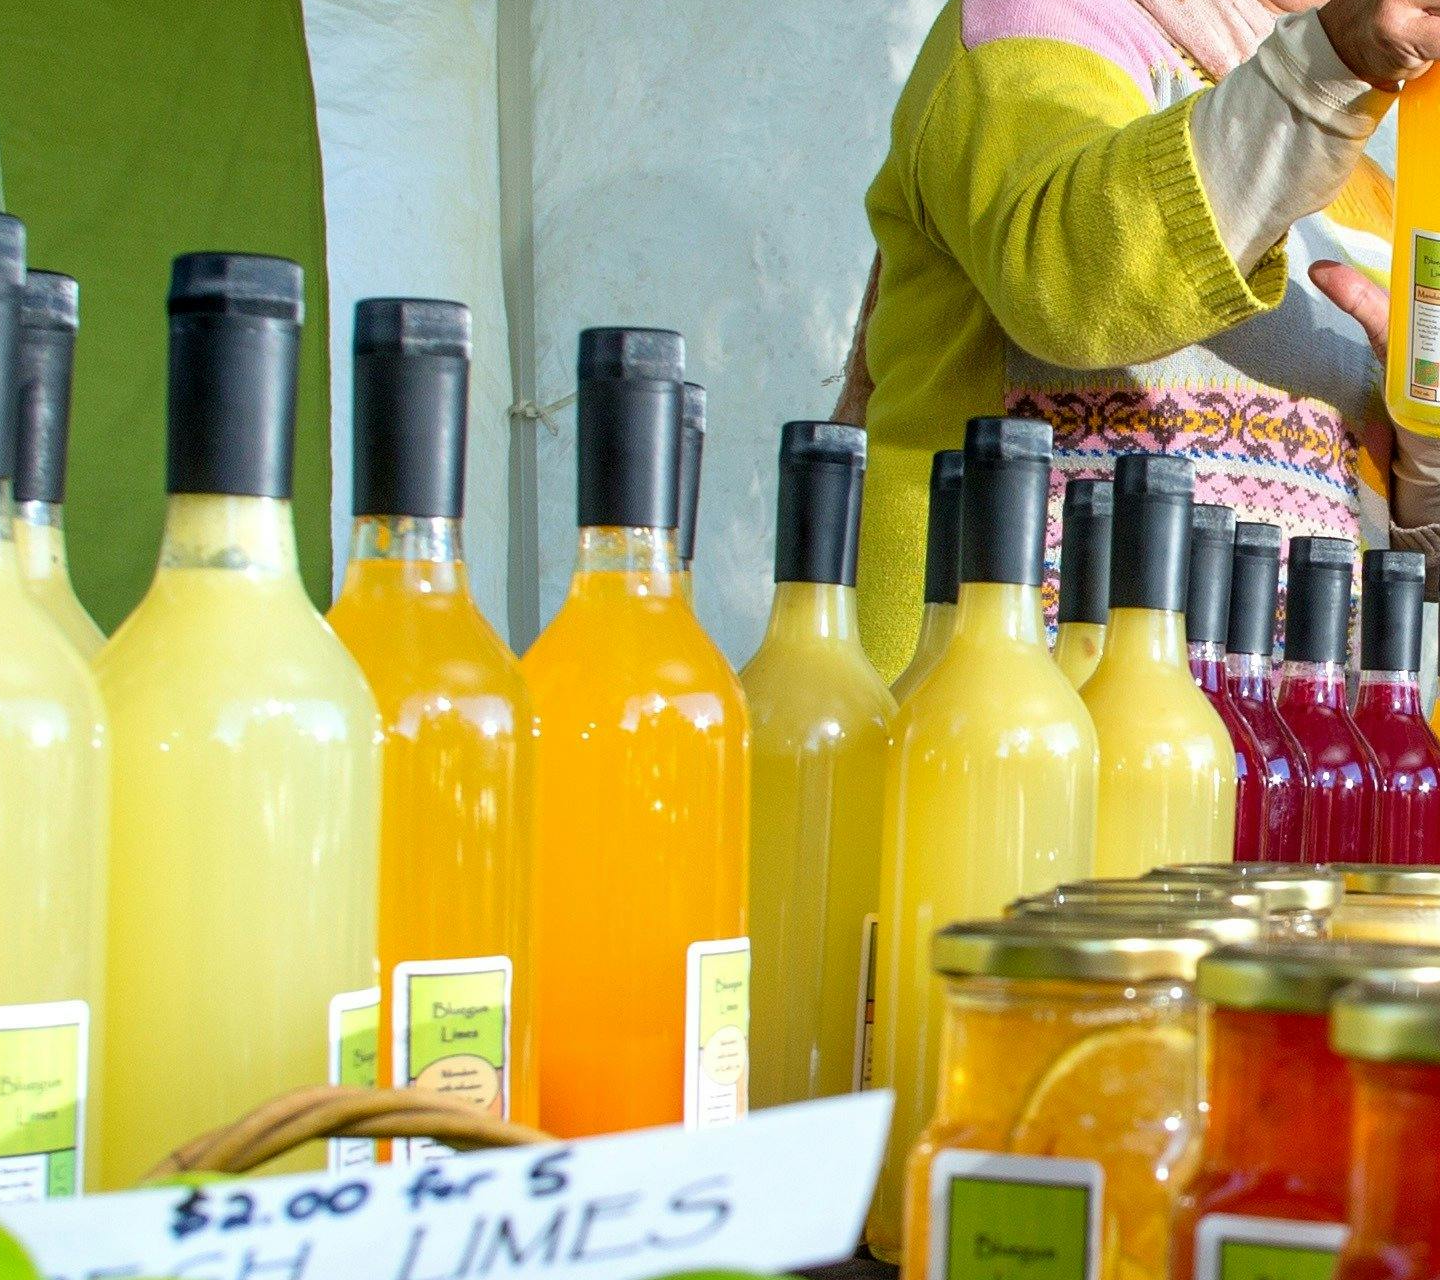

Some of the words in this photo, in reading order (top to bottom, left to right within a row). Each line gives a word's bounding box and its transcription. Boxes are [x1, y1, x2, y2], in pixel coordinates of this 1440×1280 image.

[168, 1176, 373, 1241] $2.00
[400, 1163, 497, 1213] for
[526, 1148, 574, 1202] 5
